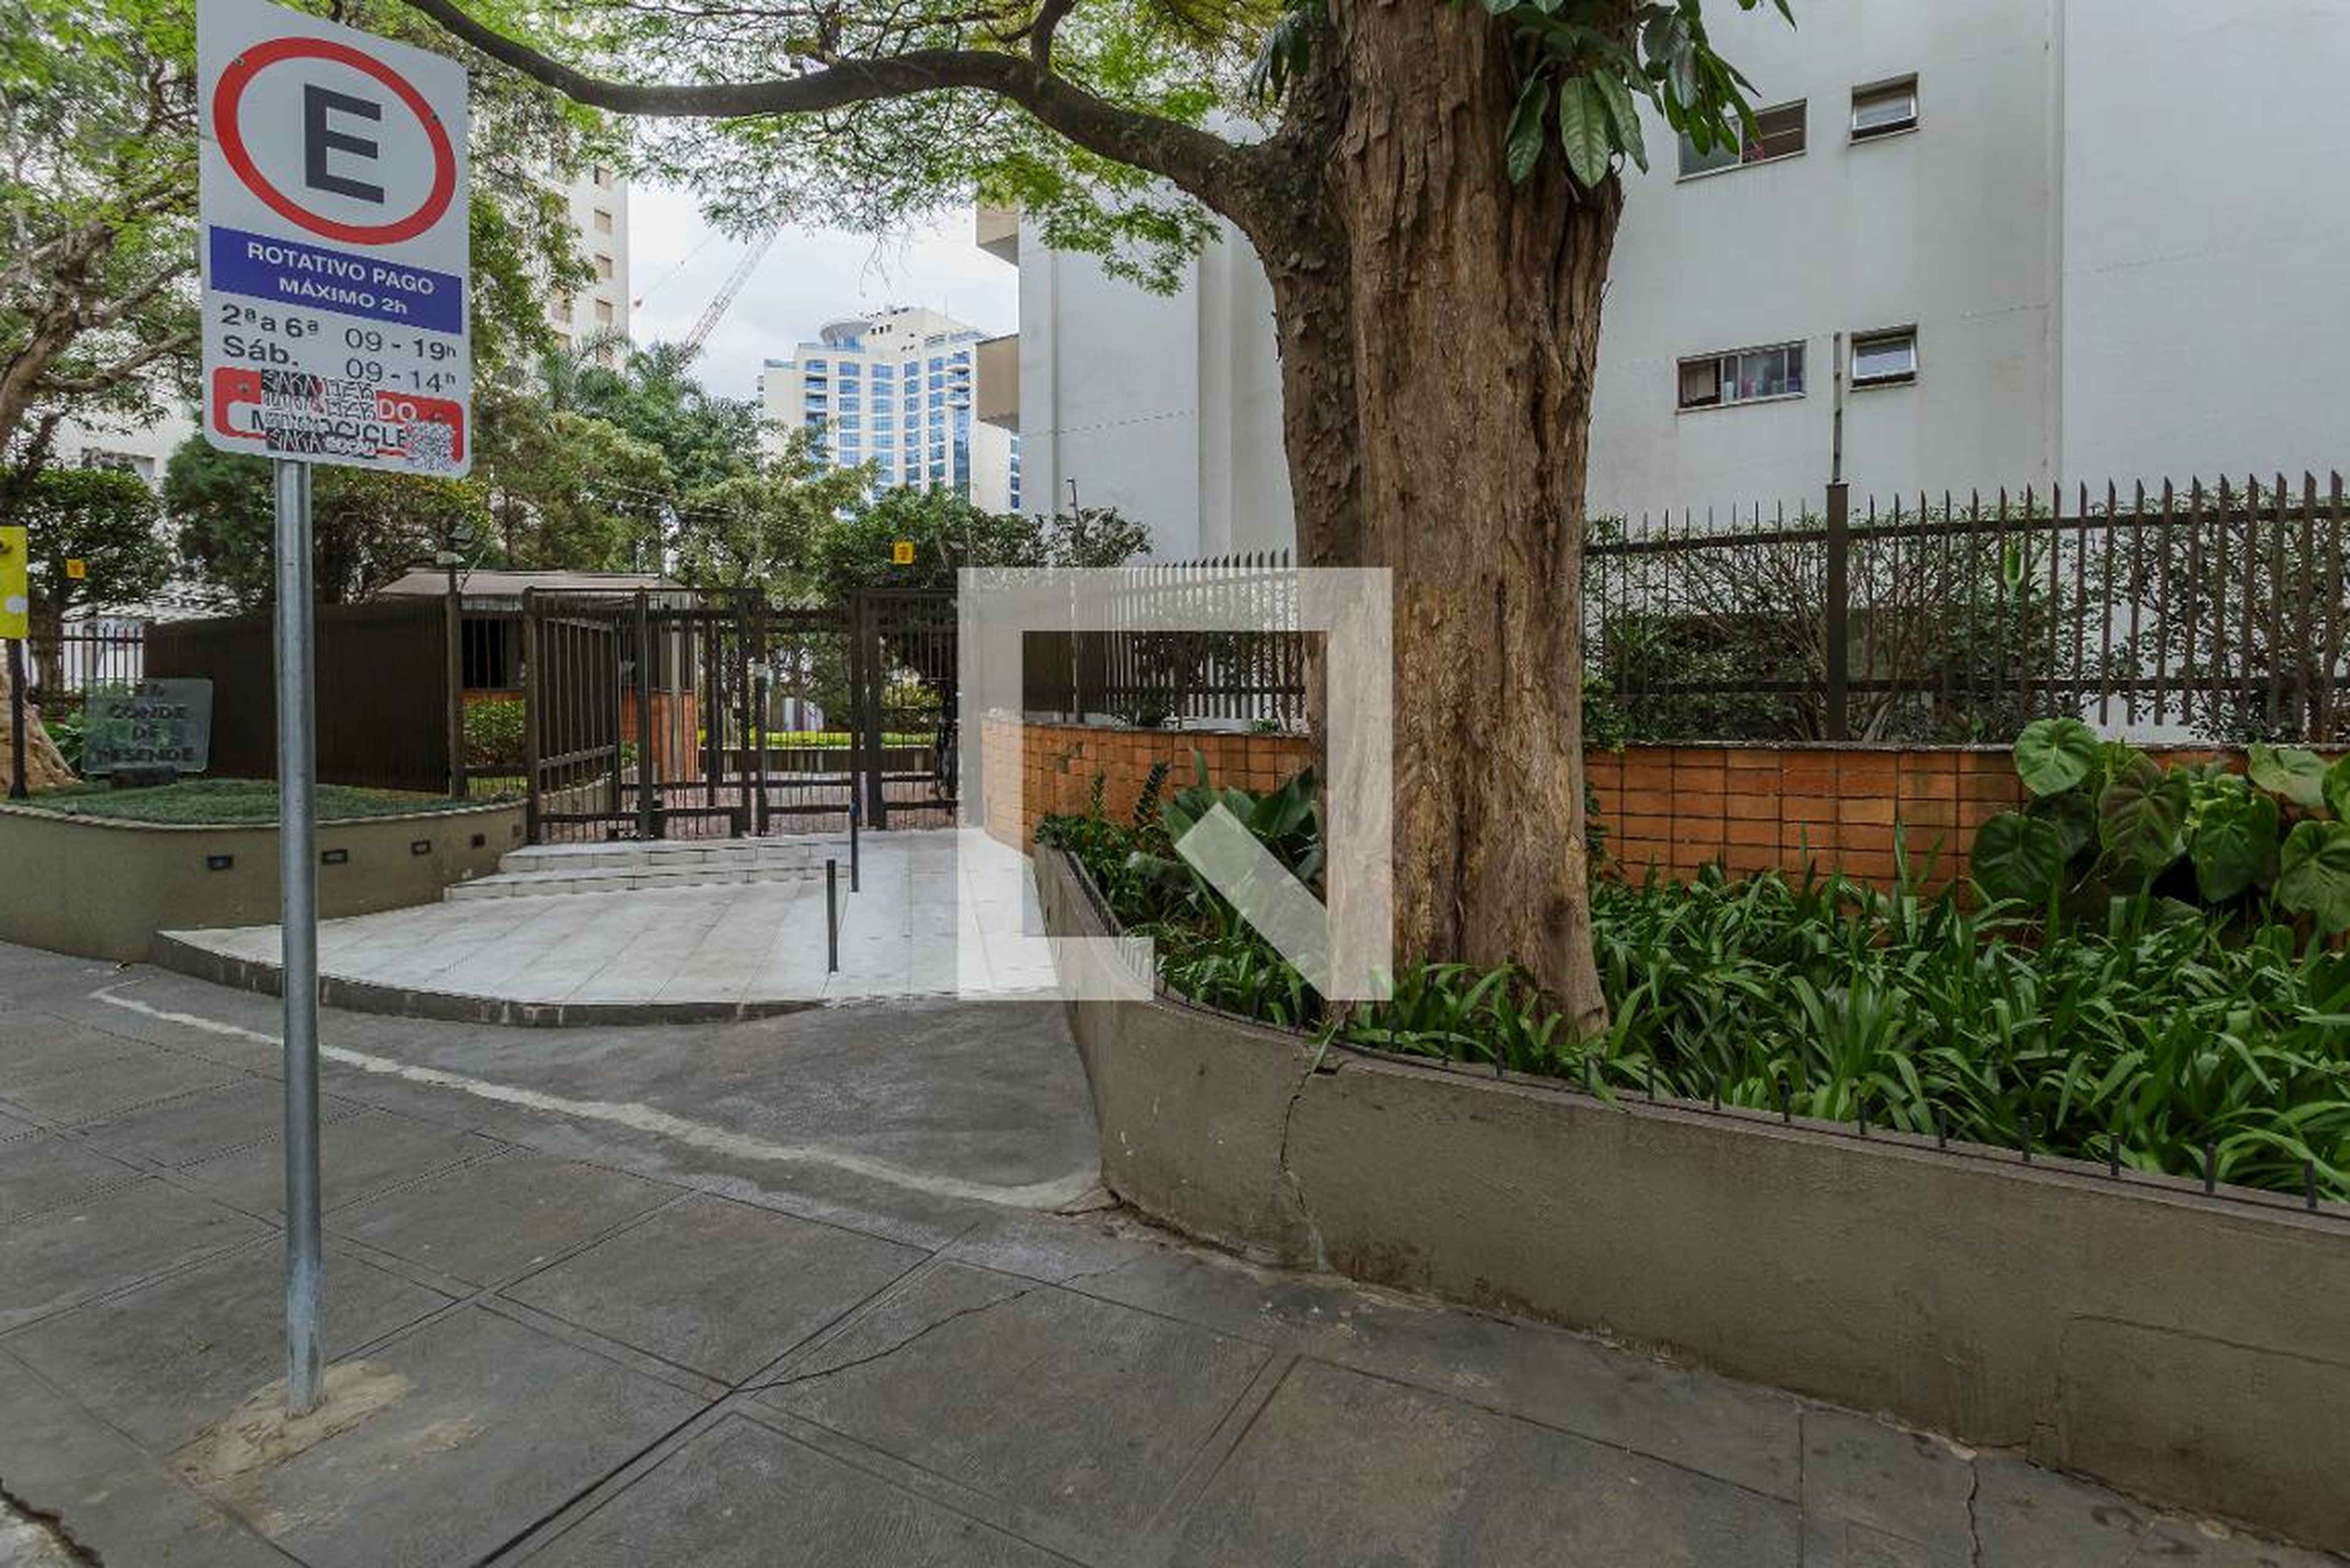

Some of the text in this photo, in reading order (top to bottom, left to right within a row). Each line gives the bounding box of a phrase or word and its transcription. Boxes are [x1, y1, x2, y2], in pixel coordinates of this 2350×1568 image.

[304, 83, 384, 204] E
[247, 241, 435, 295] ROTATIVO PAGO
[278, 277, 408, 315] MÁXIMO 2h
[223, 335, 299, 367] Sáb.
[346, 358, 383, 383] 09
[409, 370, 456, 393] 14h
[345, 328, 382, 352] 09
[412, 338, 457, 361] 19h
